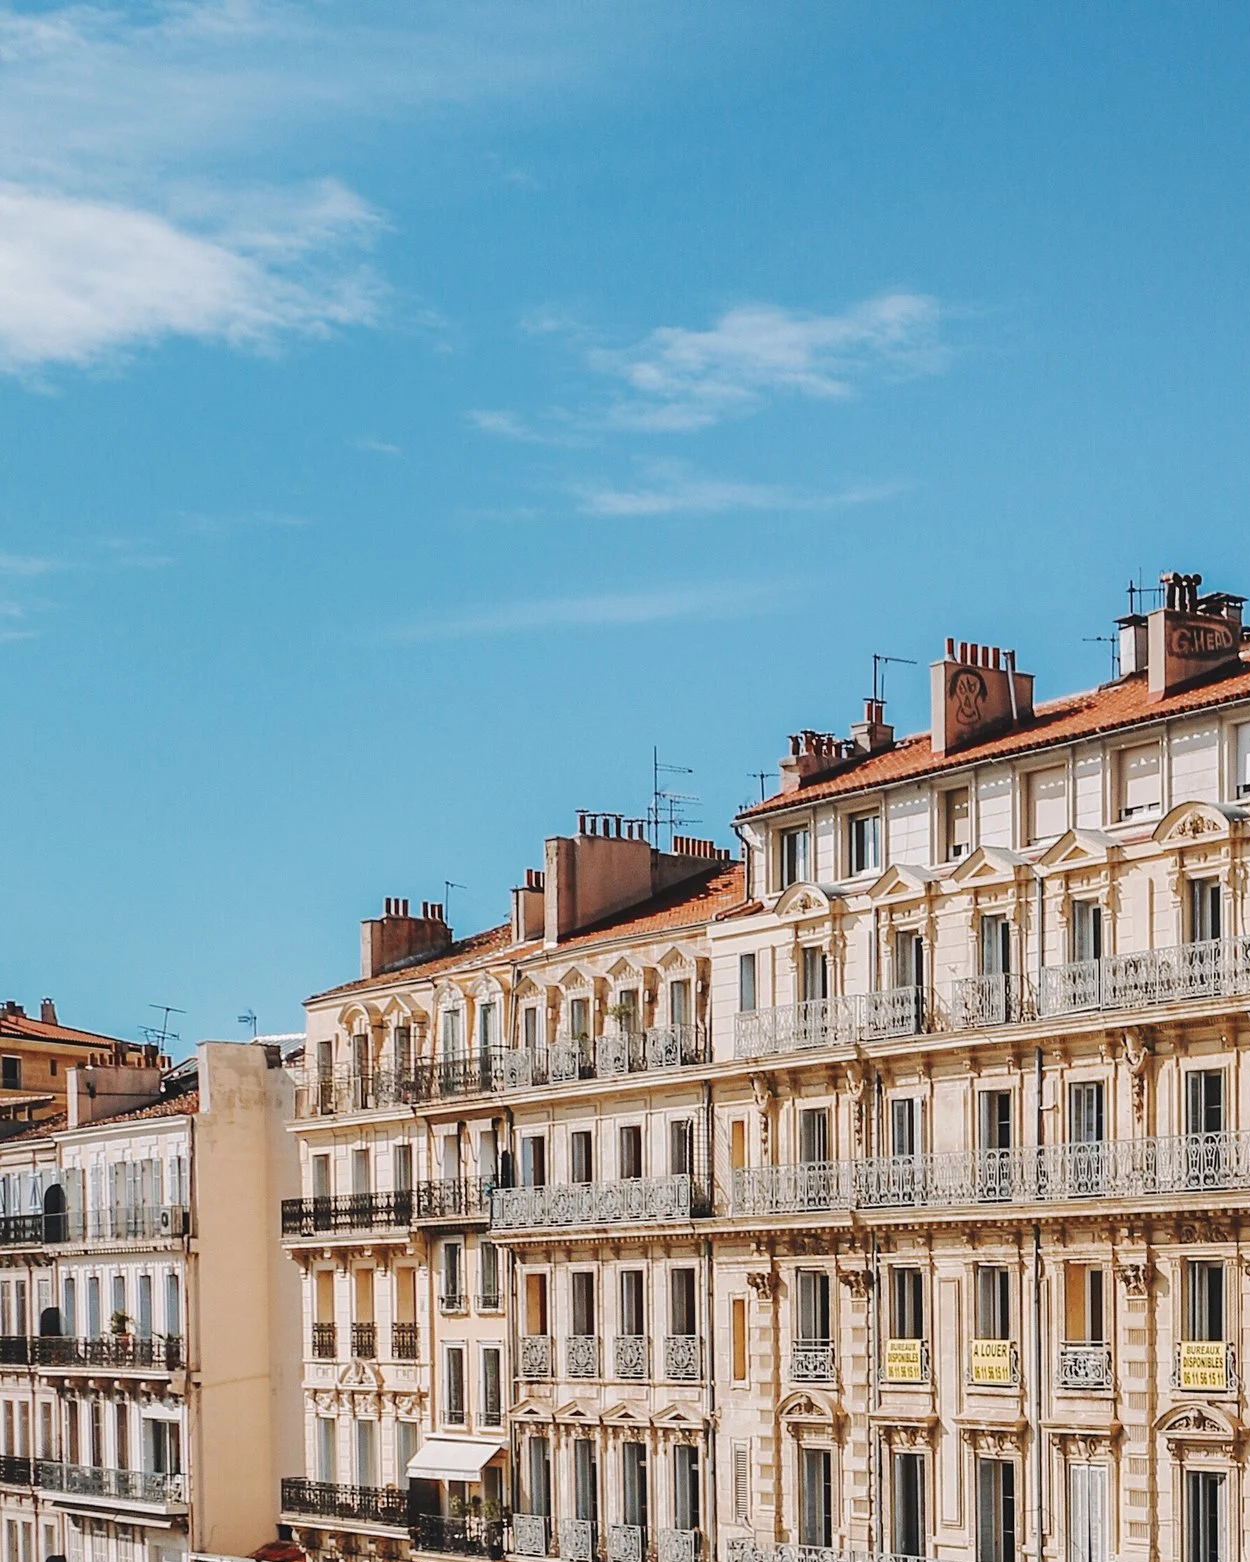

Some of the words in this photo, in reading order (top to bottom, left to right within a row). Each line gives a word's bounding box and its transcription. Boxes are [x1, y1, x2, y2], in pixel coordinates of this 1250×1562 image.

[973, 1344, 979, 1357] A
[981, 1344, 1007, 1357] LOUER
[1187, 1346, 1220, 1355] BUREAUX
[1183, 1357, 1223, 1368] DISPONIBLES
